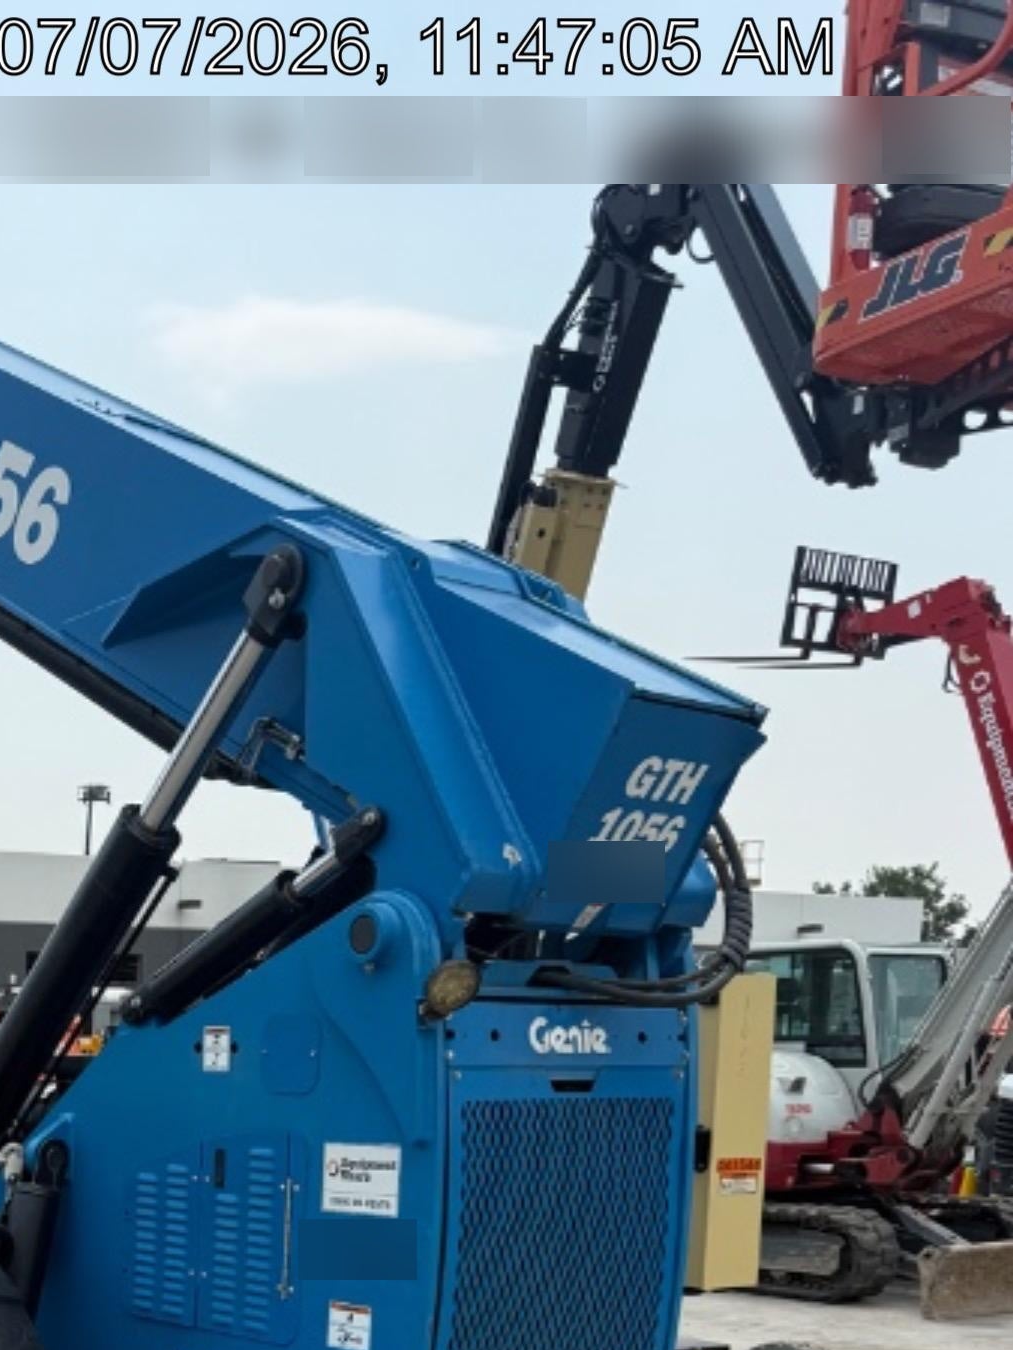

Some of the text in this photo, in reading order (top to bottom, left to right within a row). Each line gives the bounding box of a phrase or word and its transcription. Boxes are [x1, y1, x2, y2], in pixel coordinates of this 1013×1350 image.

[857, 226, 972, 323] JLG
[626, 755, 709, 805] GTH
[529, 1016, 611, 1054] Genie
